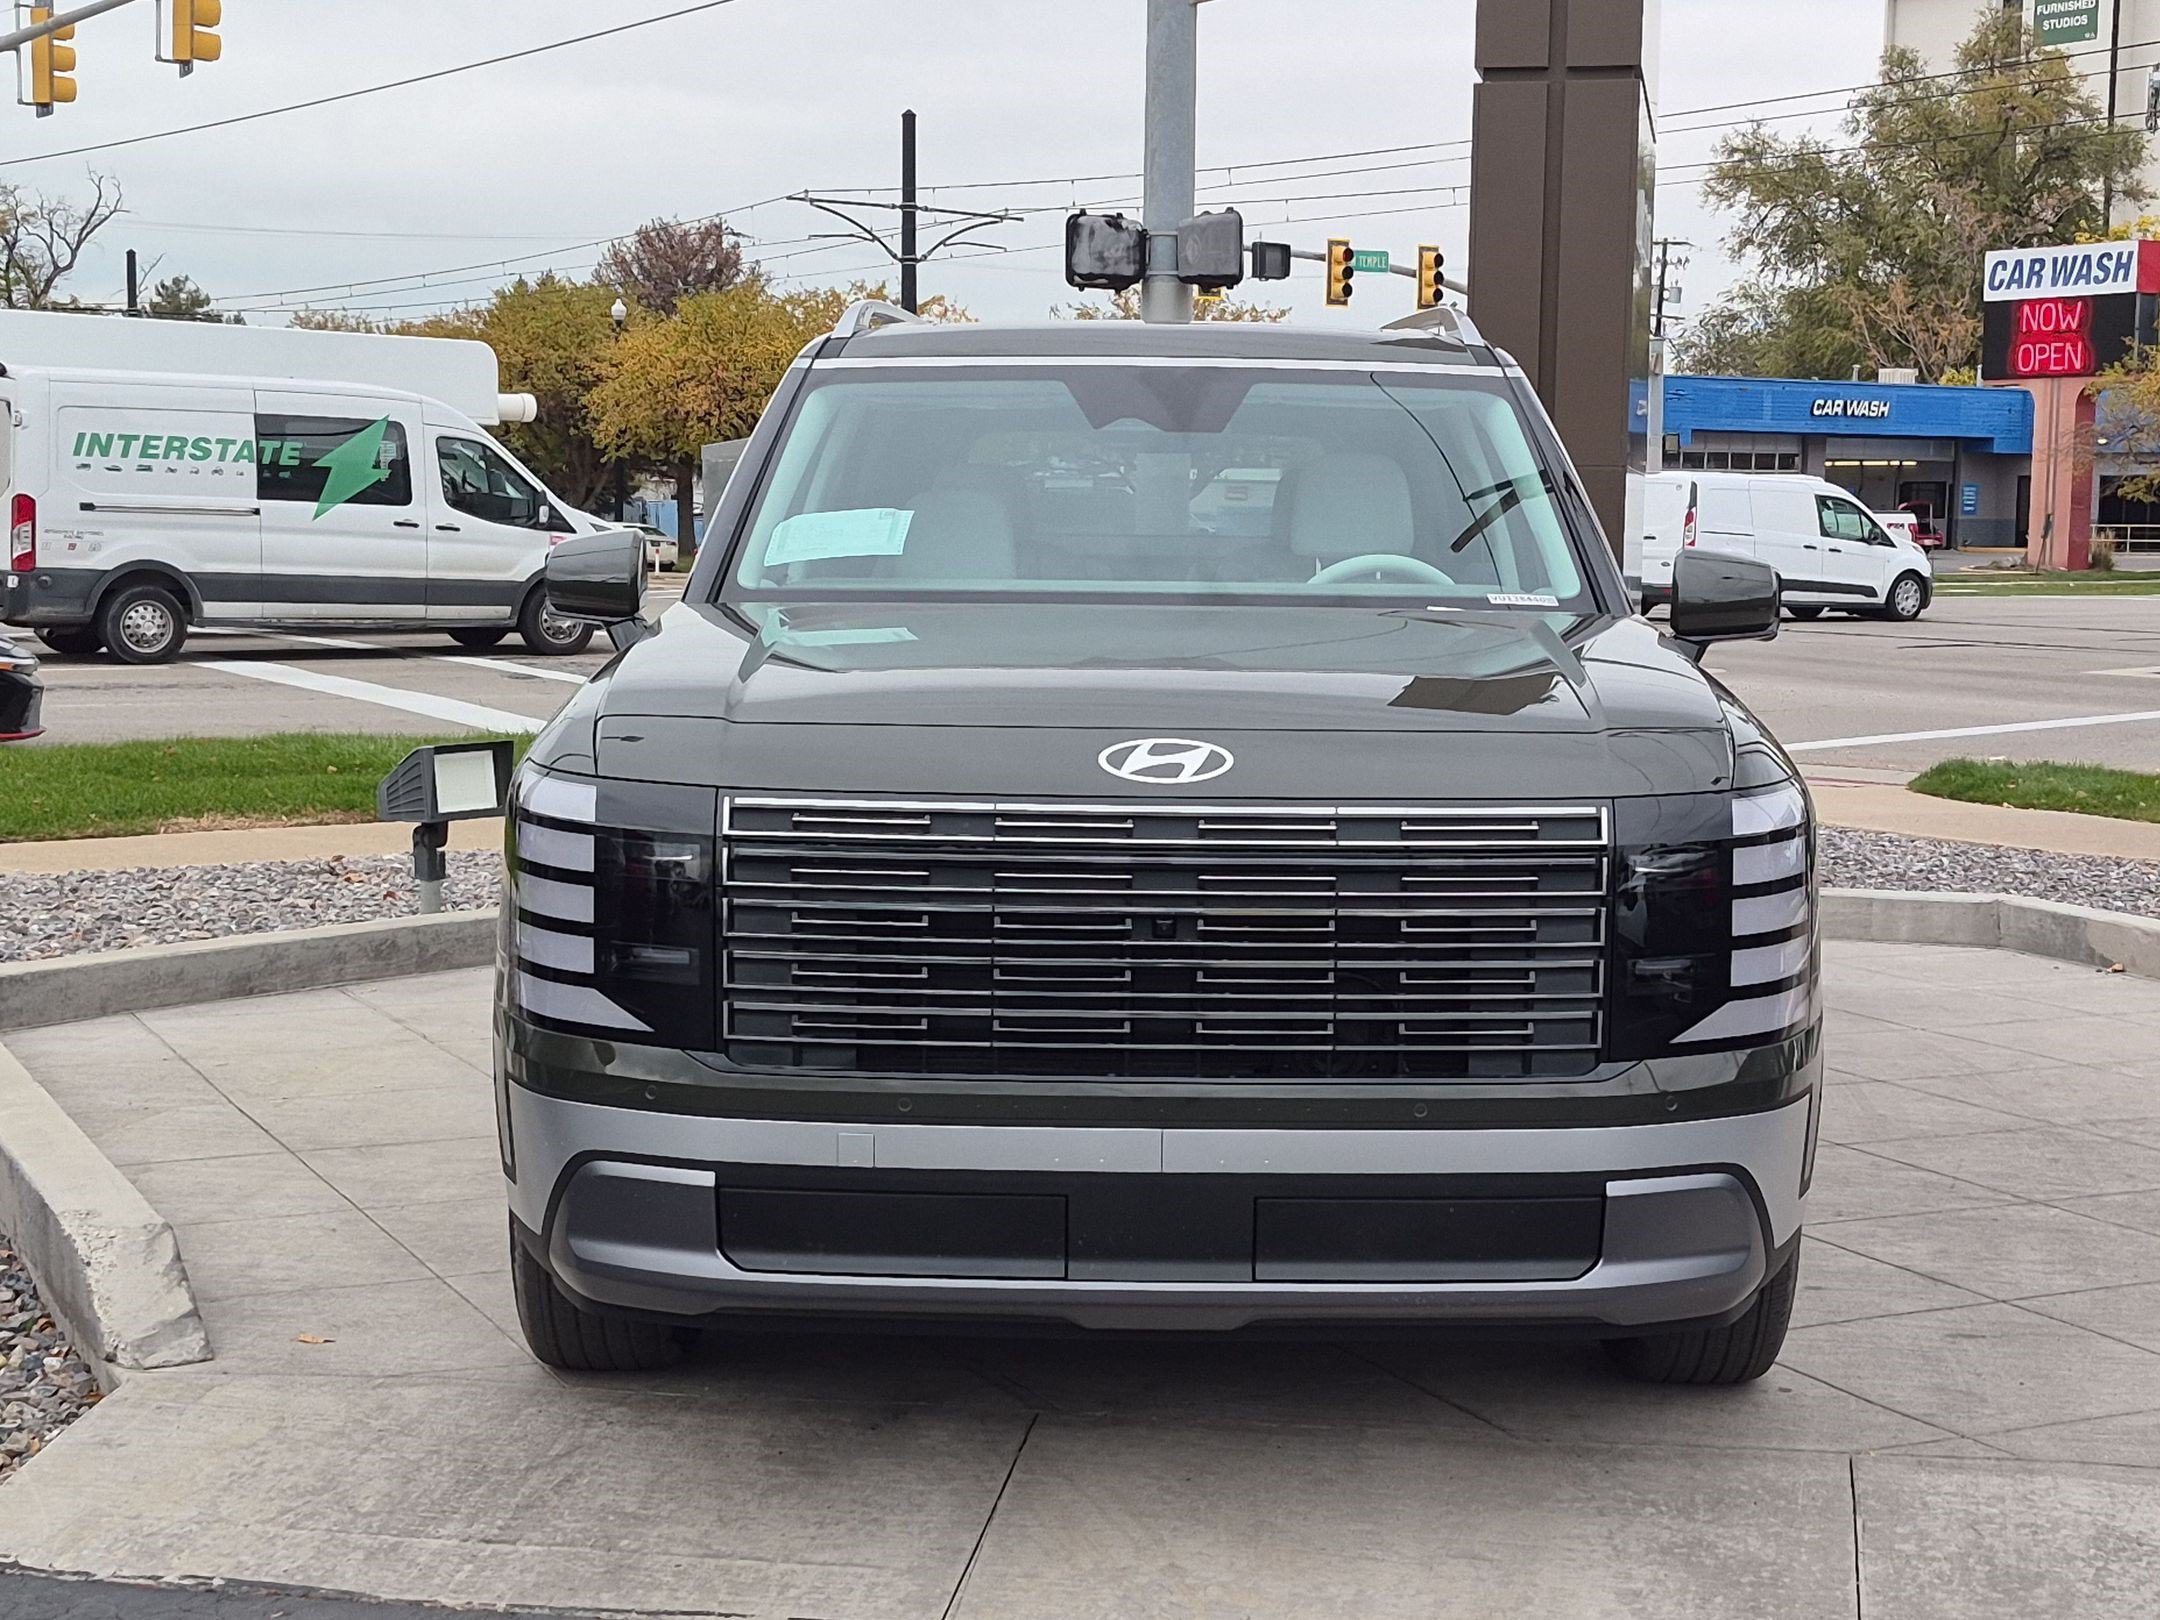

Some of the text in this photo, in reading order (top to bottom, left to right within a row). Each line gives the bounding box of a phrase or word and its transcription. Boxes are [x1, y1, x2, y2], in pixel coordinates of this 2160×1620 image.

[2037, 0, 2096, 15] FURNISHED
[2042, 15, 2088, 30] STUDIOS
[1359, 256, 1386, 268] TEMPLE
[1988, 250, 2134, 292] CAR WASH
[2022, 301, 2083, 333] NOW
[2017, 341, 2083, 372] OPEN
[1812, 399, 1890, 418] CAR WASH
[72, 432, 304, 466] INTERSTATE
